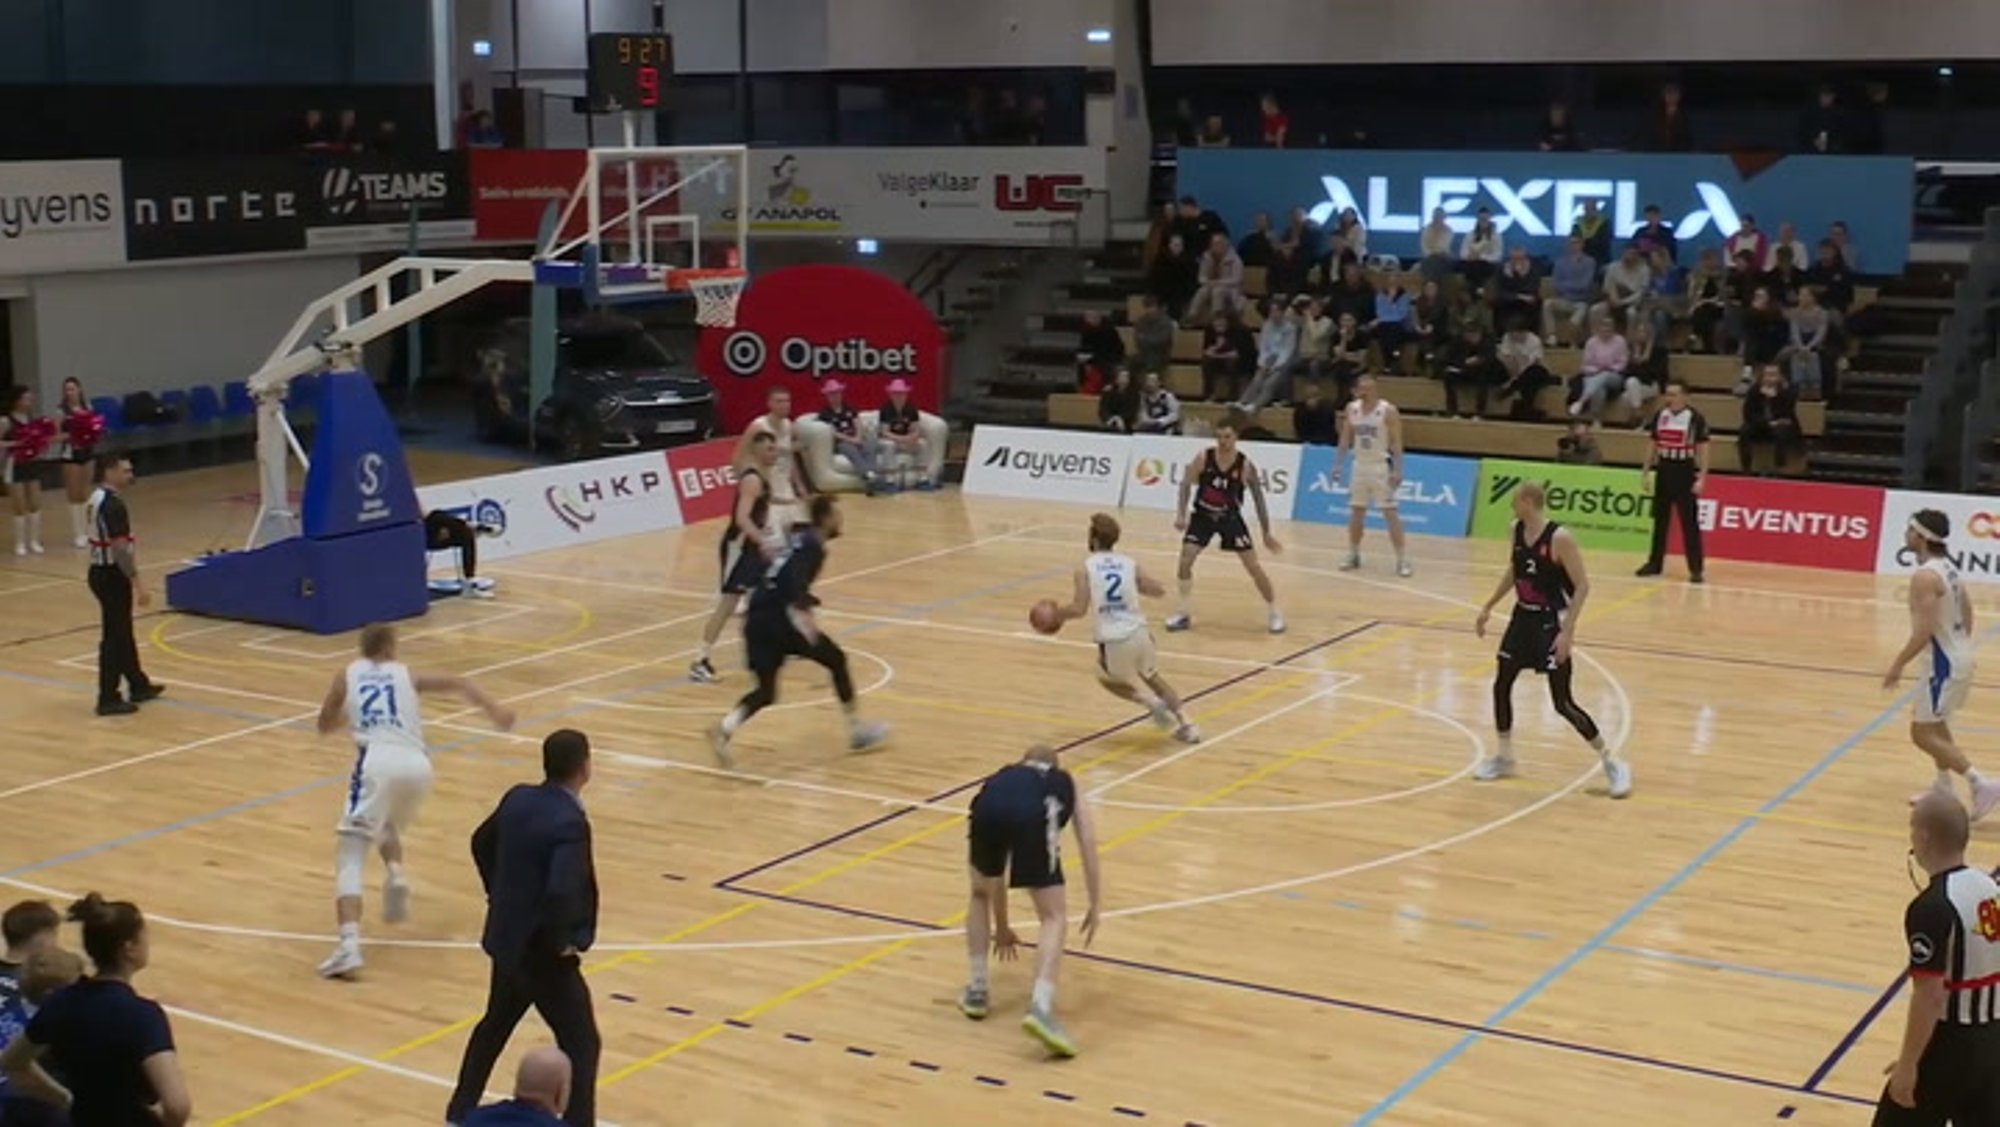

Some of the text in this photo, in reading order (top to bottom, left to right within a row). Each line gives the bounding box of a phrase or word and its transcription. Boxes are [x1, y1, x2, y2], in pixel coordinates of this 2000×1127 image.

[638, 67, 659, 105] 9
[134, 189, 298, 225] norte
[720, 207, 842, 220] GANAPOL
[780, 337, 918, 377] Optibet
[1012, 448, 1112, 478] ayvens
[579, 470, 660, 502] HKP
[1309, 471, 1457, 506] ALELA
[1543, 480, 1654, 518] erston
[1720, 506, 1869, 540] EVENTUS
[1525, 559, 1537, 574] 2
[1895, 546, 2000, 578] CNN
[1105, 573, 1123, 602] 2
[360, 685, 397, 717] 21
